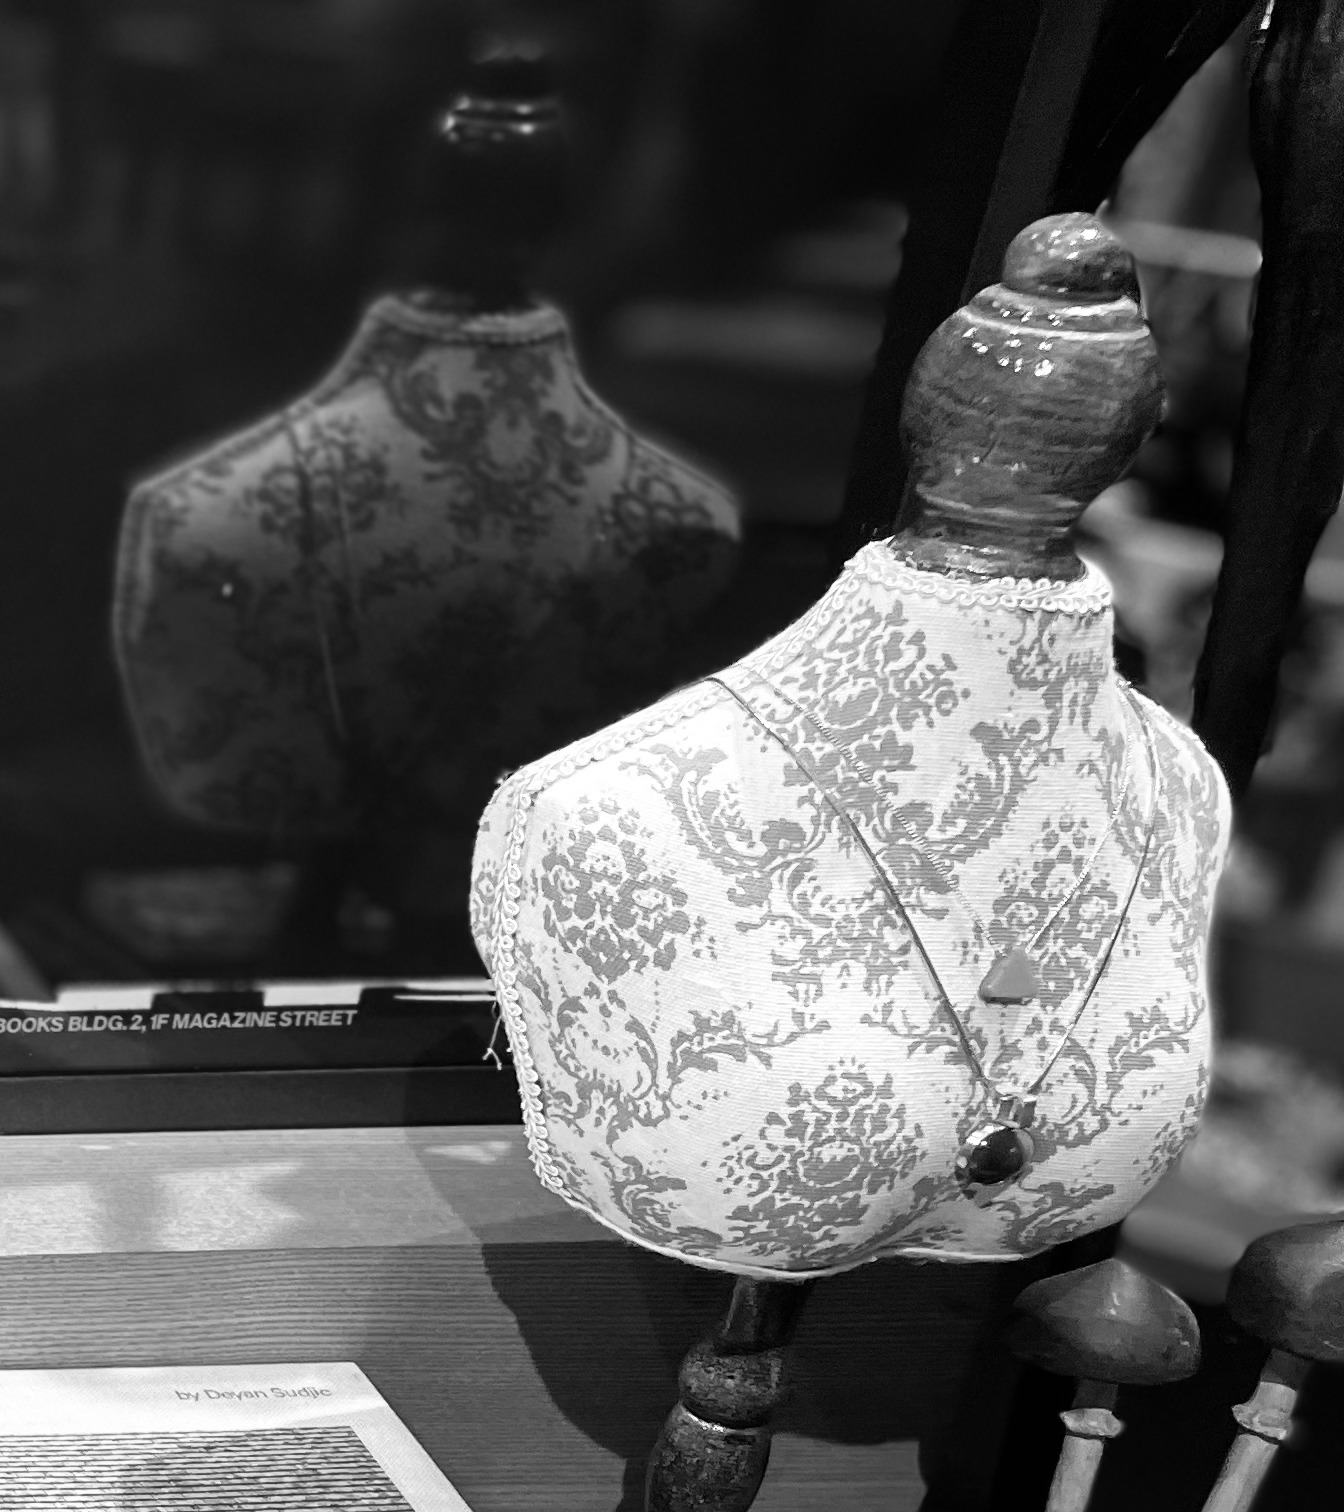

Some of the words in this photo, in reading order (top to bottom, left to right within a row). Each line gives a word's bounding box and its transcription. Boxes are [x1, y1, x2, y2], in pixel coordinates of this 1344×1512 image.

[68, 1014, 127, 1032] BLDG.
[172, 1011, 278, 1029] MAGAZINE
[278, 1009, 358, 1027] STREET
[174, 1390, 200, 1402] by
[270, 1386, 333, 1400] Sudjic
